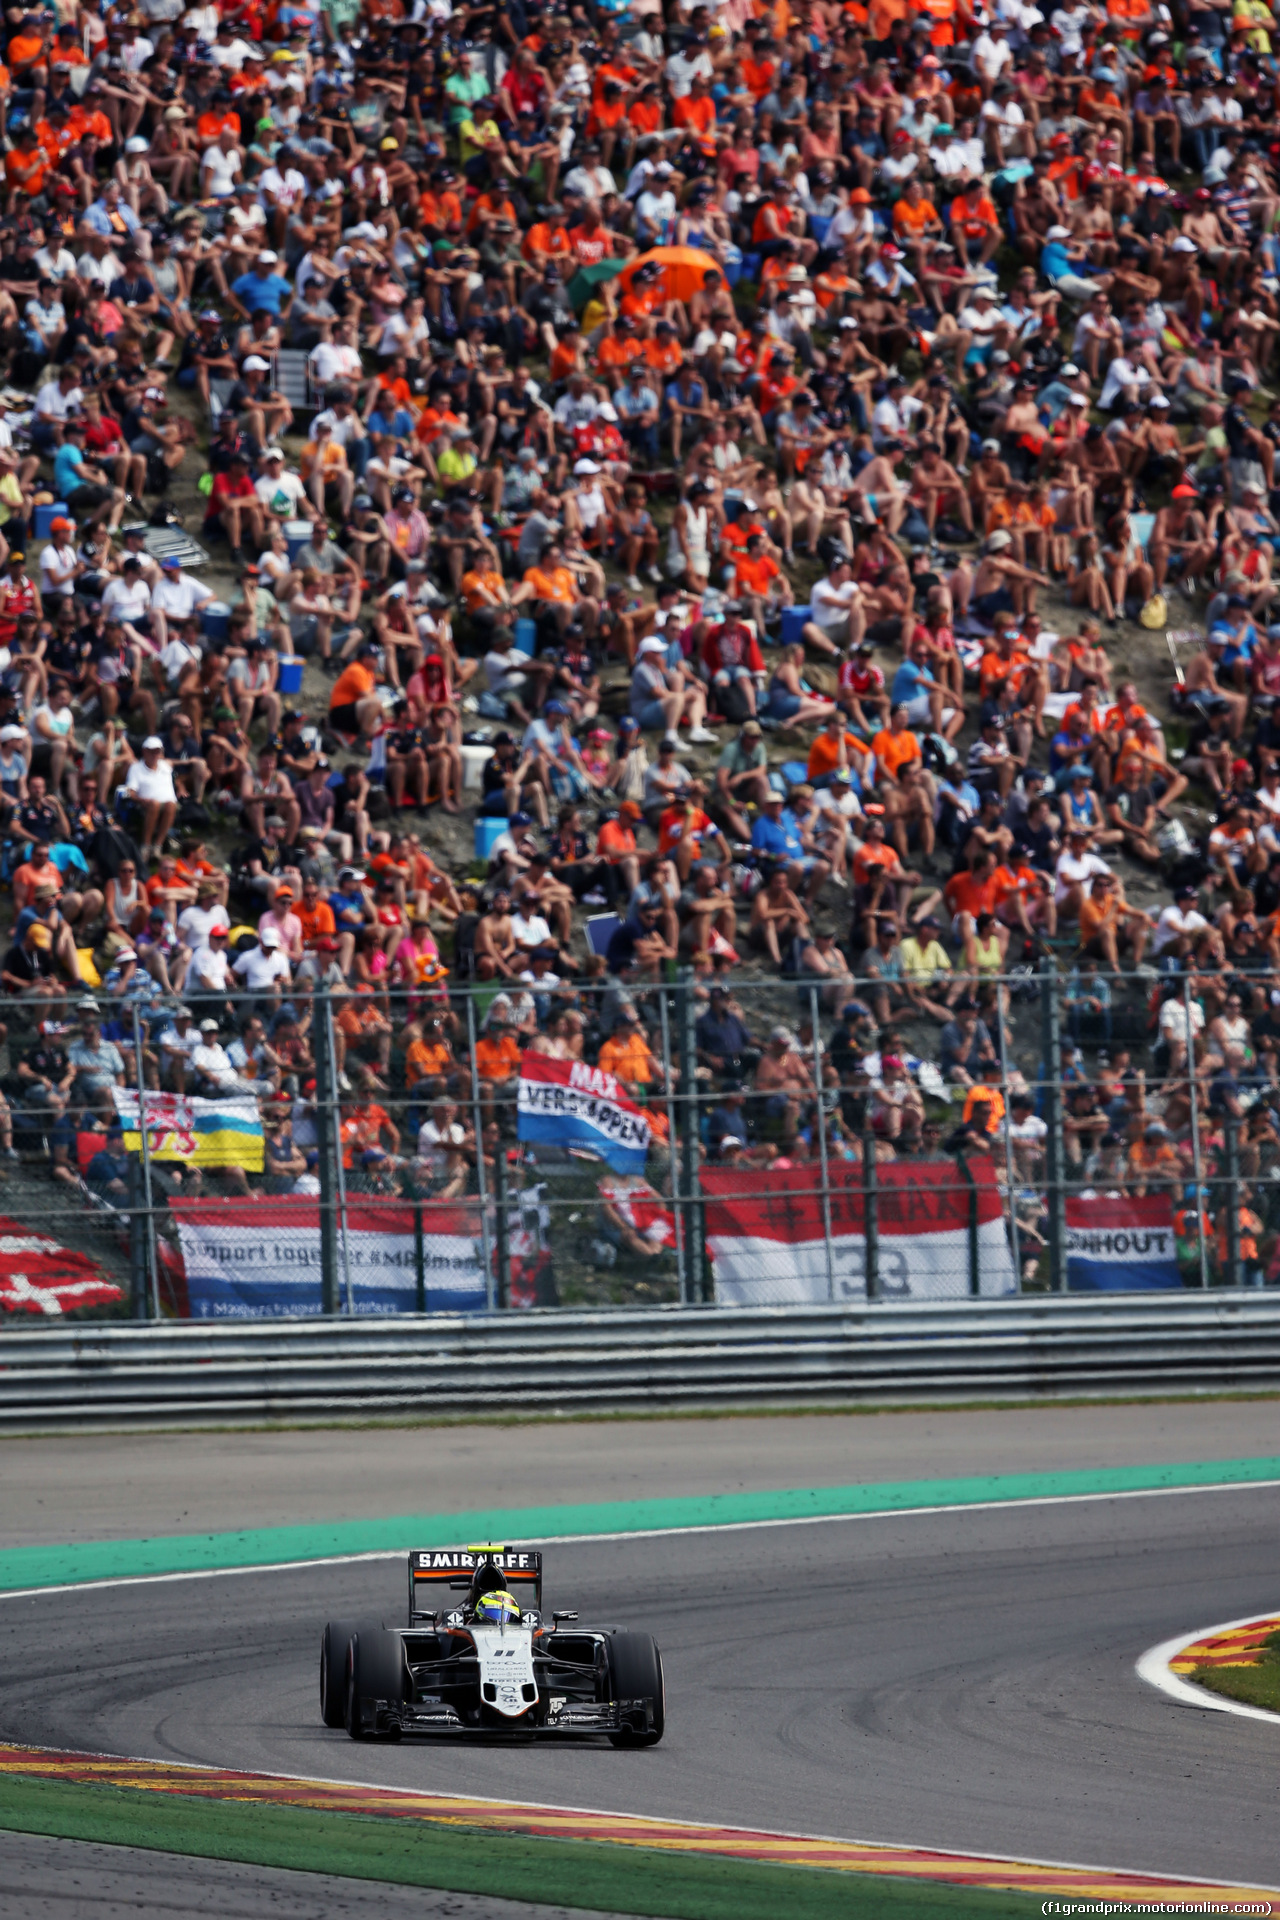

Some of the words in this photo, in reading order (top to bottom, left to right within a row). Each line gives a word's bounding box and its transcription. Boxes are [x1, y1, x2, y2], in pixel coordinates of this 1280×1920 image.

[569, 1062, 617, 1100] MAX
[527, 1085, 646, 1143] VERSAPPEN
[186, 1240, 266, 1263] Support
[273, 1242, 364, 1267] togeer
[834, 1246, 912, 1296] 33
[419, 1553, 529, 1567] SMIRNOFF
